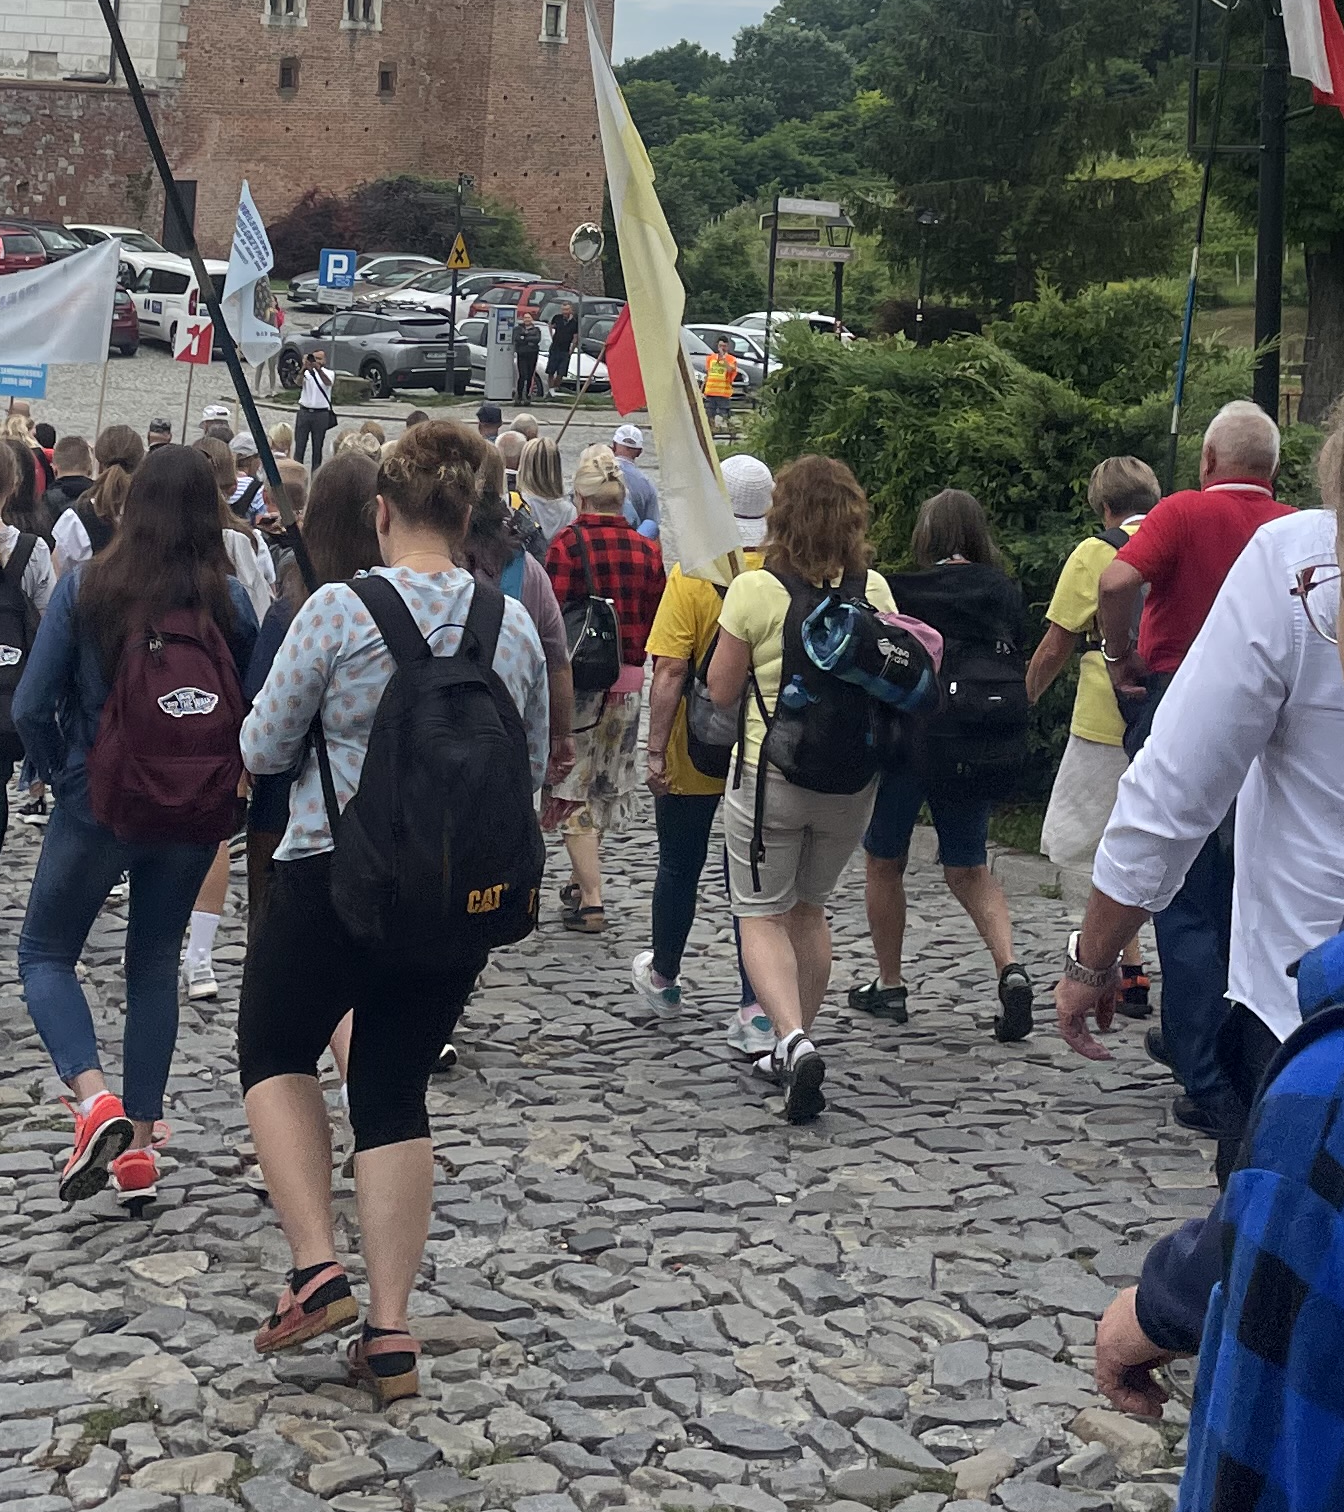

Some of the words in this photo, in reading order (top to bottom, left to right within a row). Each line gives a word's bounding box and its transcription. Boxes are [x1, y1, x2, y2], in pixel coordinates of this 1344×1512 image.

[326, 253, 349, 283] P
[186, 323, 201, 356] 1
[467, 884, 504, 914] CAT
